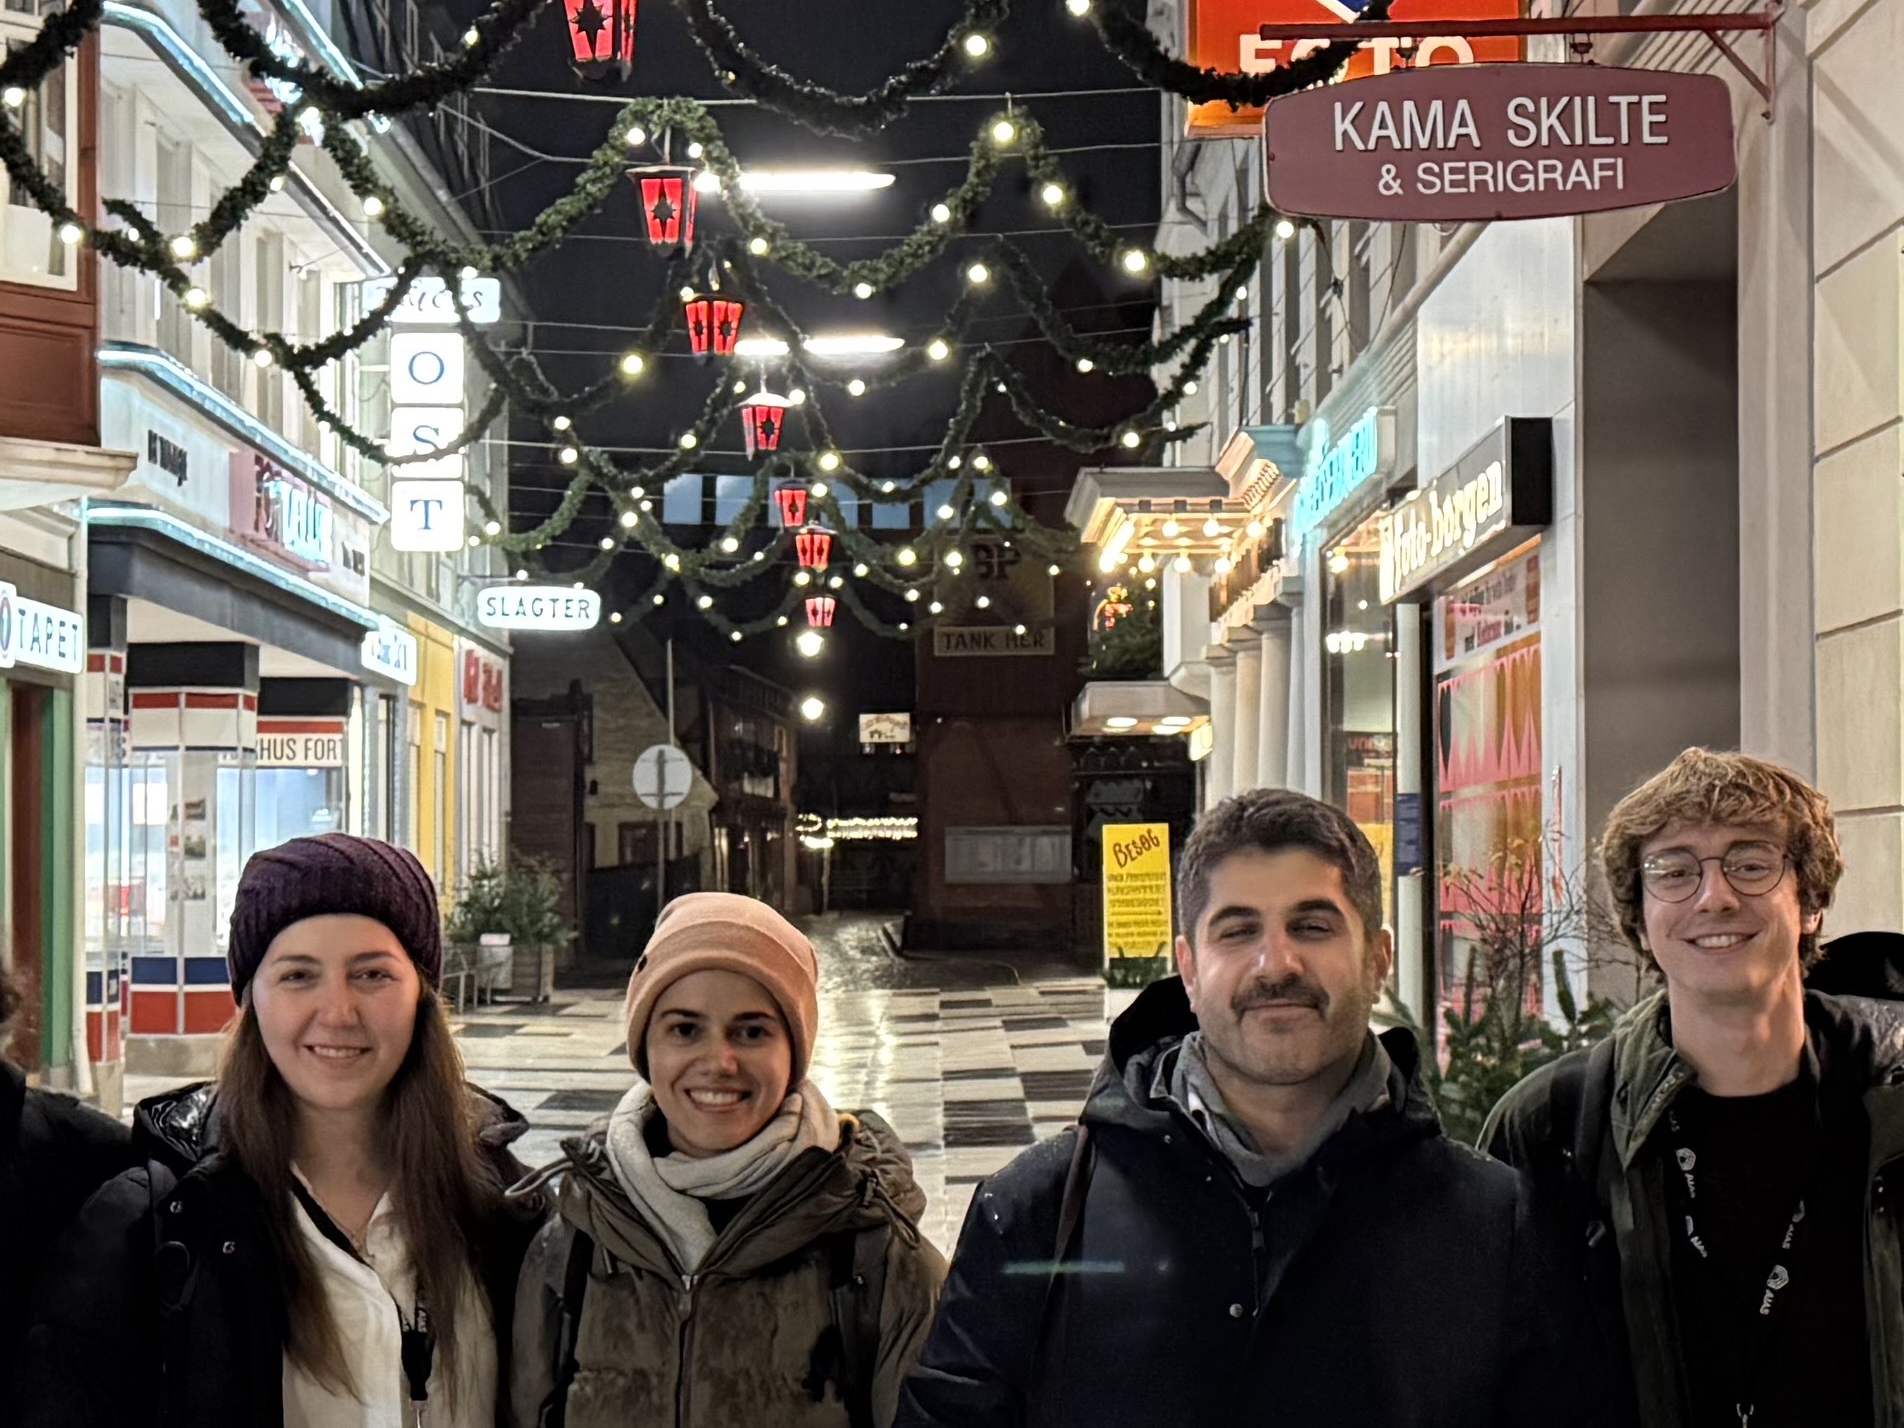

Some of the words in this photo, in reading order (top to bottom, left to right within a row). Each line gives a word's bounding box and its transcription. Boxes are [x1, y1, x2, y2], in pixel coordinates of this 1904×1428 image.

[1334, 98, 1481, 151] KAMA
[1506, 94, 1669, 148] SKILTE
[1378, 163, 1404, 196] &
[1416, 157, 1624, 195] SERIGRAFI
[1394, 460, 1503, 593] foto-borgen
[486, 596, 591, 619] SLAGTER
[17, 607, 80, 662] TAPET
[943, 631, 996, 651] TANK
[1005, 629, 1045, 649] HER
